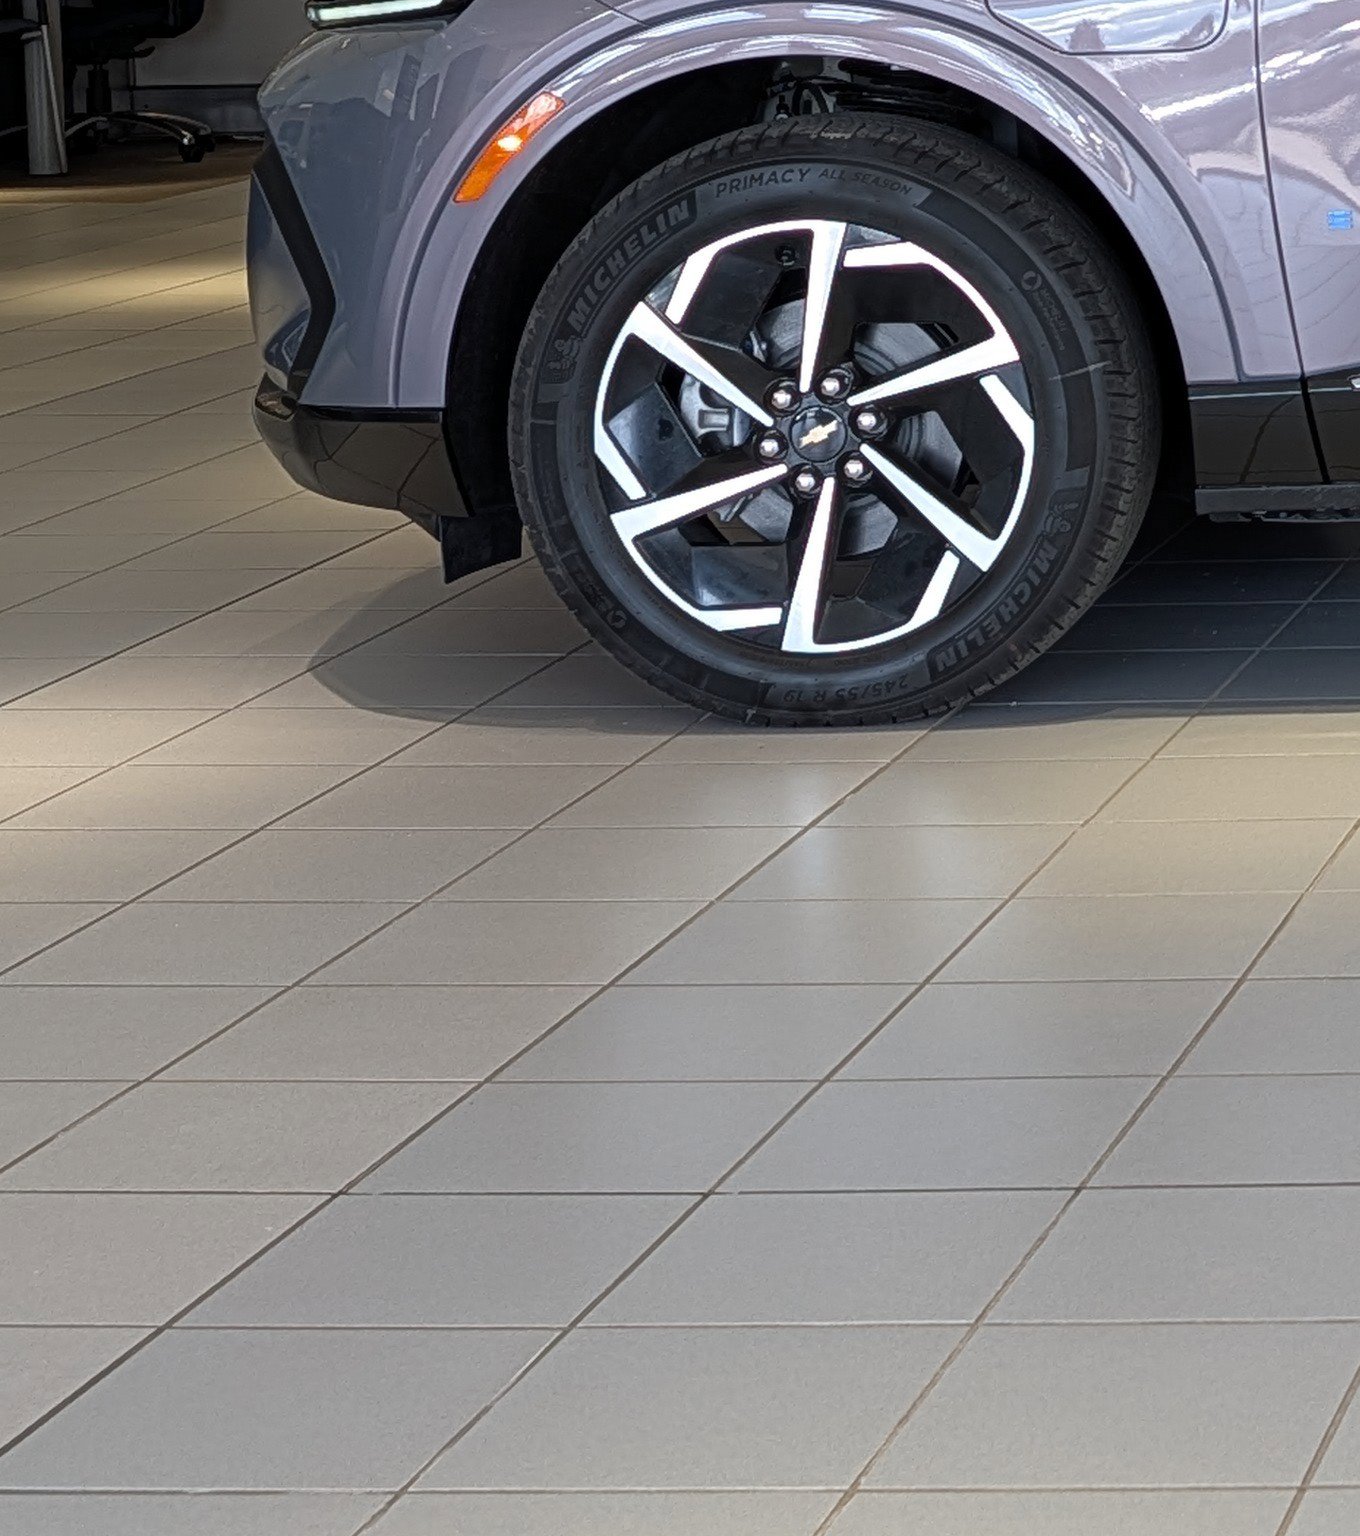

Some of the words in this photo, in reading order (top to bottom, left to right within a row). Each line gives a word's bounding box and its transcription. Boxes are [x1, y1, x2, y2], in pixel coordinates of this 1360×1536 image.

[715, 167, 811, 198] PRIMACY
[818, 168, 845, 182] ALL
[853, 171, 913, 196] SEASON
[565, 198, 690, 332] MICHELIN
[934, 539, 1059, 673] MICHELIN
[835, 672, 909, 702] 245/55
